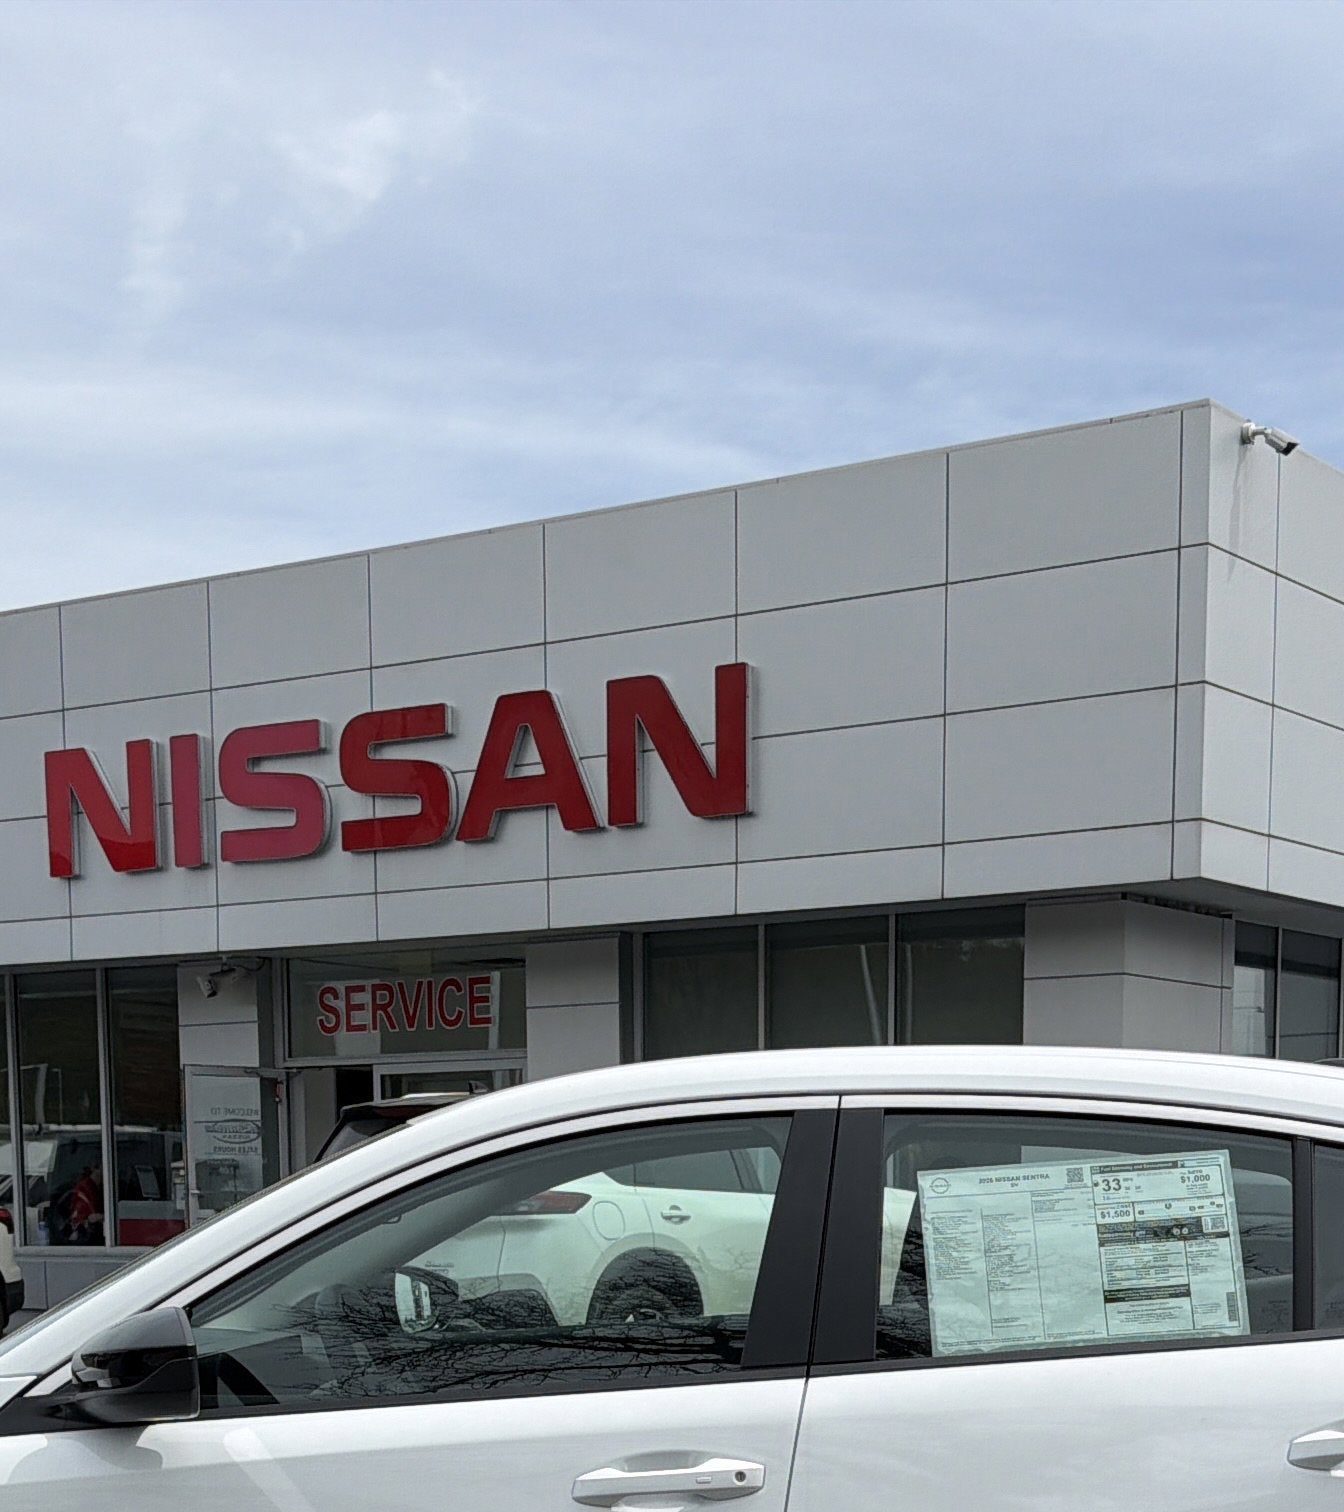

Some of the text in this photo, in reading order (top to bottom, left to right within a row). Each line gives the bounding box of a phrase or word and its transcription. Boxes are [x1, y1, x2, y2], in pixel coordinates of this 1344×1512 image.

[43, 661, 752, 878] NISSAN
[316, 974, 493, 1037] SERVICE
[994, 1175, 1021, 1183] NISSAN
[1022, 1173, 1050, 1181] SENTRA
[1101, 1177, 1122, 1192] 33
[1180, 1173, 1211, 1184] $1,000
[1100, 1209, 1131, 1220] $1,500
